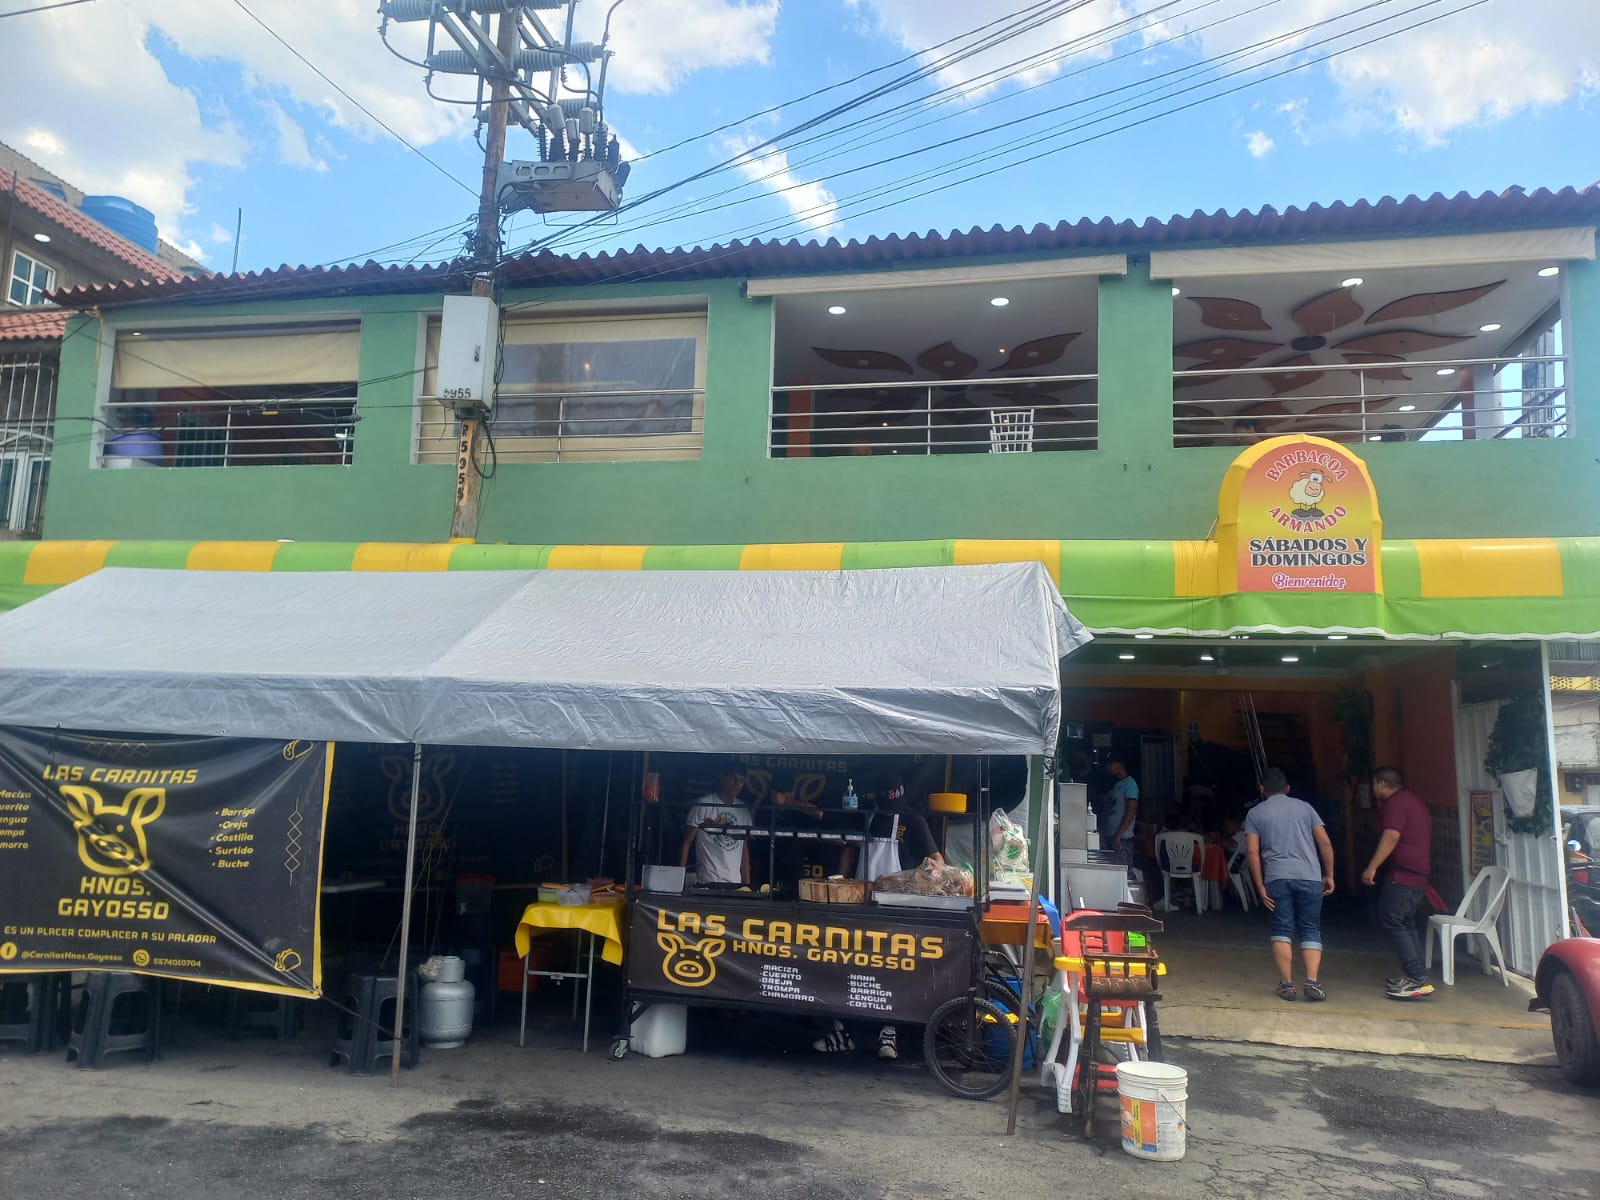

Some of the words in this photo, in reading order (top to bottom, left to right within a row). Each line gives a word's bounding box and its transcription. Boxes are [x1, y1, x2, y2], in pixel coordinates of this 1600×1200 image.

[1265, 449, 1348, 482] BARBACOA
[1267, 505, 1347, 533] ARMANDO
[1249, 536, 1347, 552] SÁBADOS
[1353, 538, 1369, 552] Y
[1251, 552, 1367, 567] DOMINGOS
[1272, 573, 1347, 590] Bienvenidos
[43, 764, 84, 781] LAS
[90, 767, 198, 785] CARNITAS
[0, 803, 30, 811] uerito
[221, 808, 256, 817] Barriga
[0, 829, 26, 838] ompa
[222, 820, 248, 831] Oreja
[216, 832, 253, 842] Costilla
[215, 846, 254, 855] Surtido
[218, 859, 249, 868] Buche
[80, 876, 151, 896] HNOS.
[58, 898, 169, 919] GAYOSSO
[4, 926, 17, 935] ES
[20, 926, 34, 935] UN
[37, 927, 74, 937] PLACER
[78, 929, 138, 940] COMPLACER
[141, 932, 148, 940] A
[151, 932, 165, 942] SU
[167, 933, 216, 944] PALADAR
[656, 908, 727, 937] LAS
[742, 918, 945, 959] CARNITAS
[732, 940, 798, 960] HNOS.
[807, 947, 917, 972] GAYOSSO
